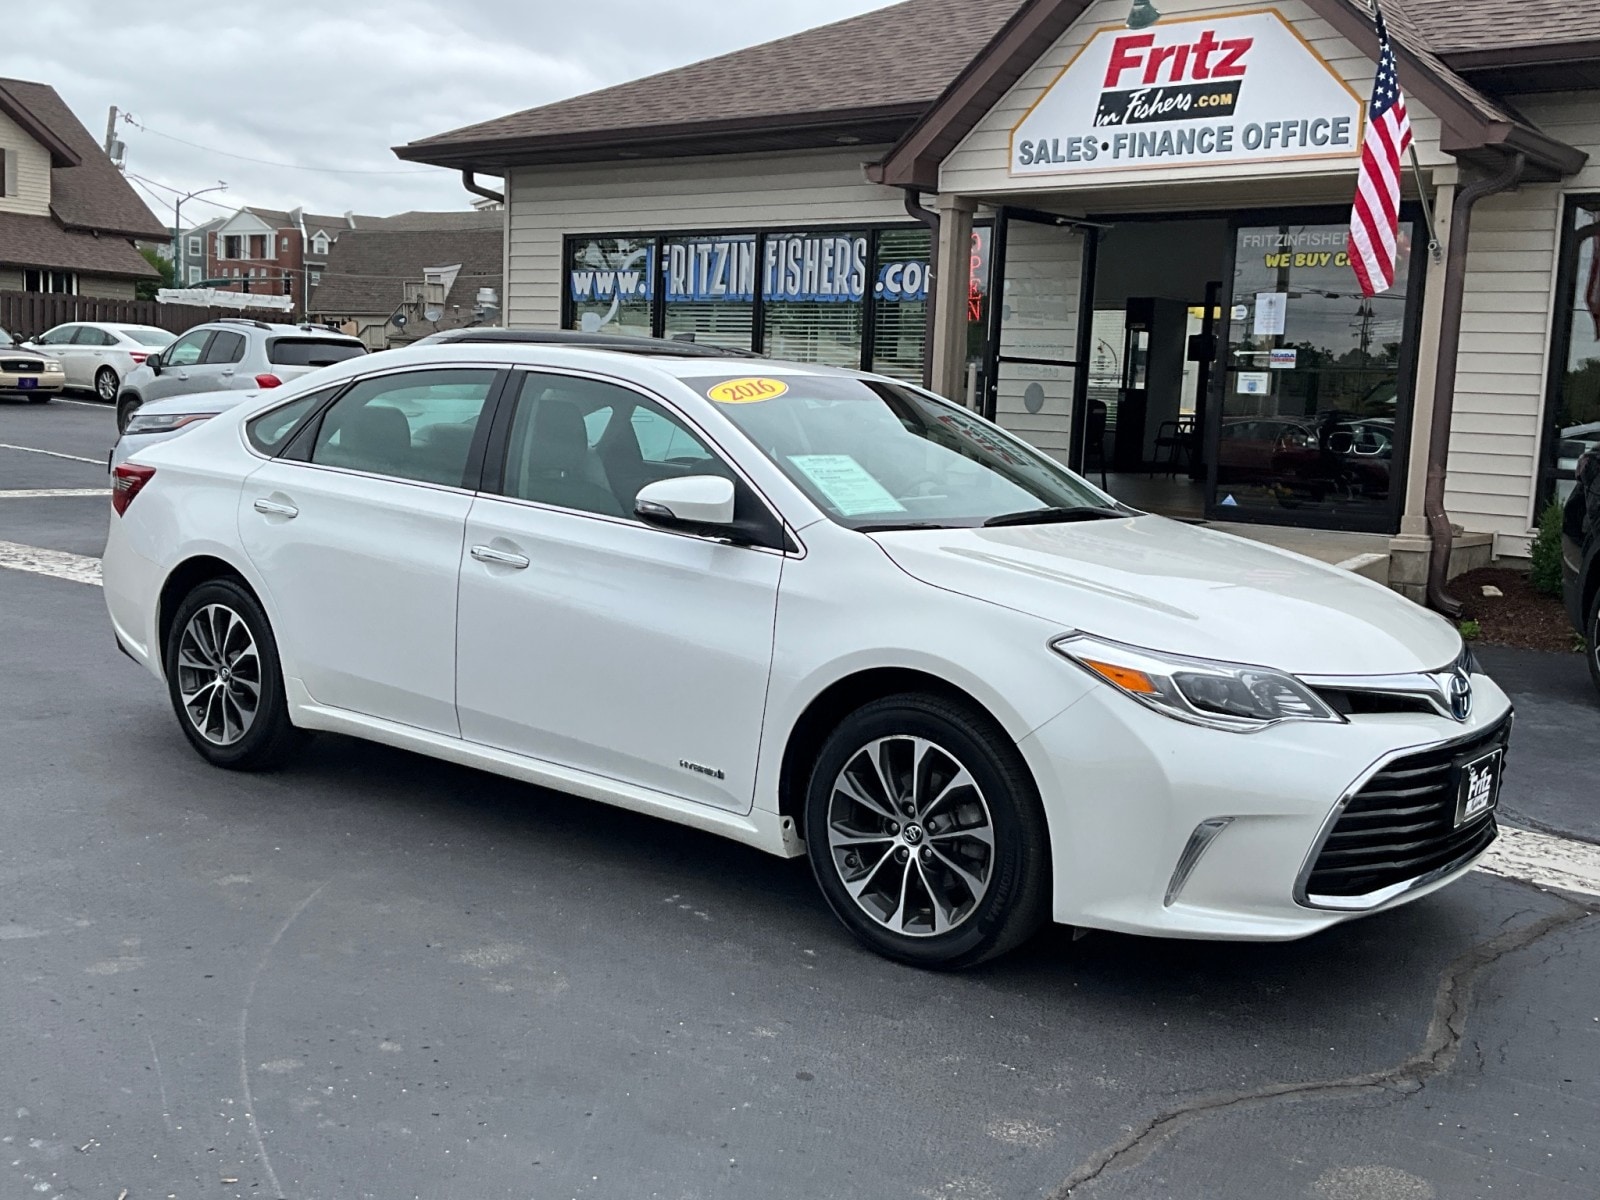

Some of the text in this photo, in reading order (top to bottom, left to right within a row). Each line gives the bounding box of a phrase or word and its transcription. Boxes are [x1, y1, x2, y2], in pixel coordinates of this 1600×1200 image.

[1103, 30, 1254, 88] Fritz
[1096, 104, 1121, 126] in
[1018, 116, 1351, 166] SALES FINANCE OFFICE
[1264, 252, 1291, 268] WE
[1294, 251, 1332, 267] BUY
[721, 378, 776, 401] 2016
[1467, 773, 1492, 801] Fritz
